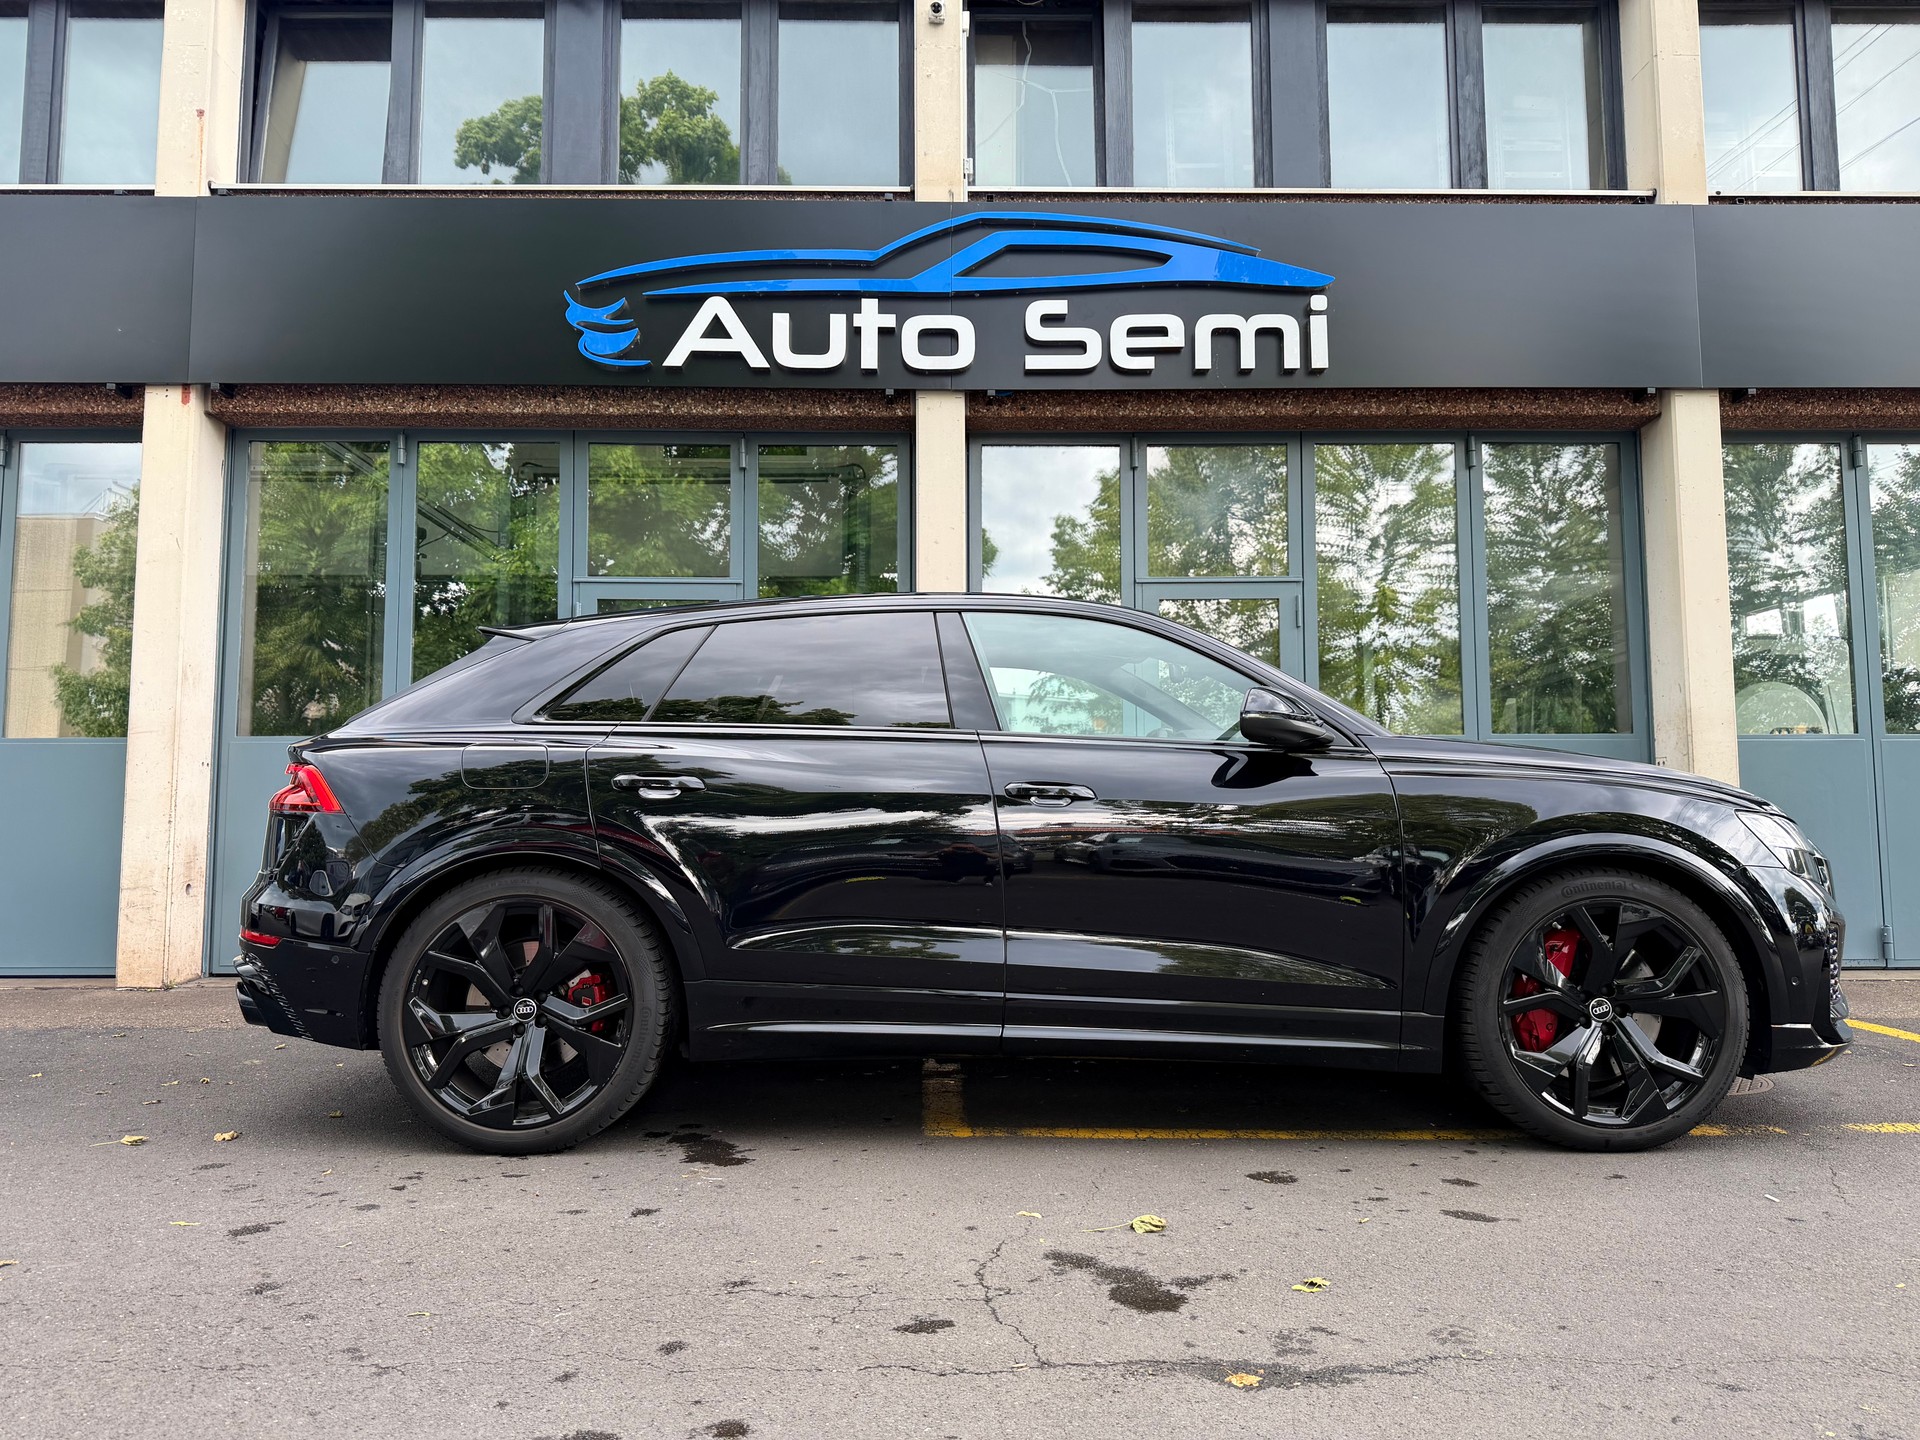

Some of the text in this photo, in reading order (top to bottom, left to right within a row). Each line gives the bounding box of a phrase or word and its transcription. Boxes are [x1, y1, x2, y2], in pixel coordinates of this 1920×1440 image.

[663, 295, 1329, 370] Auto Semi
[1561, 880, 1627, 899] Continental
